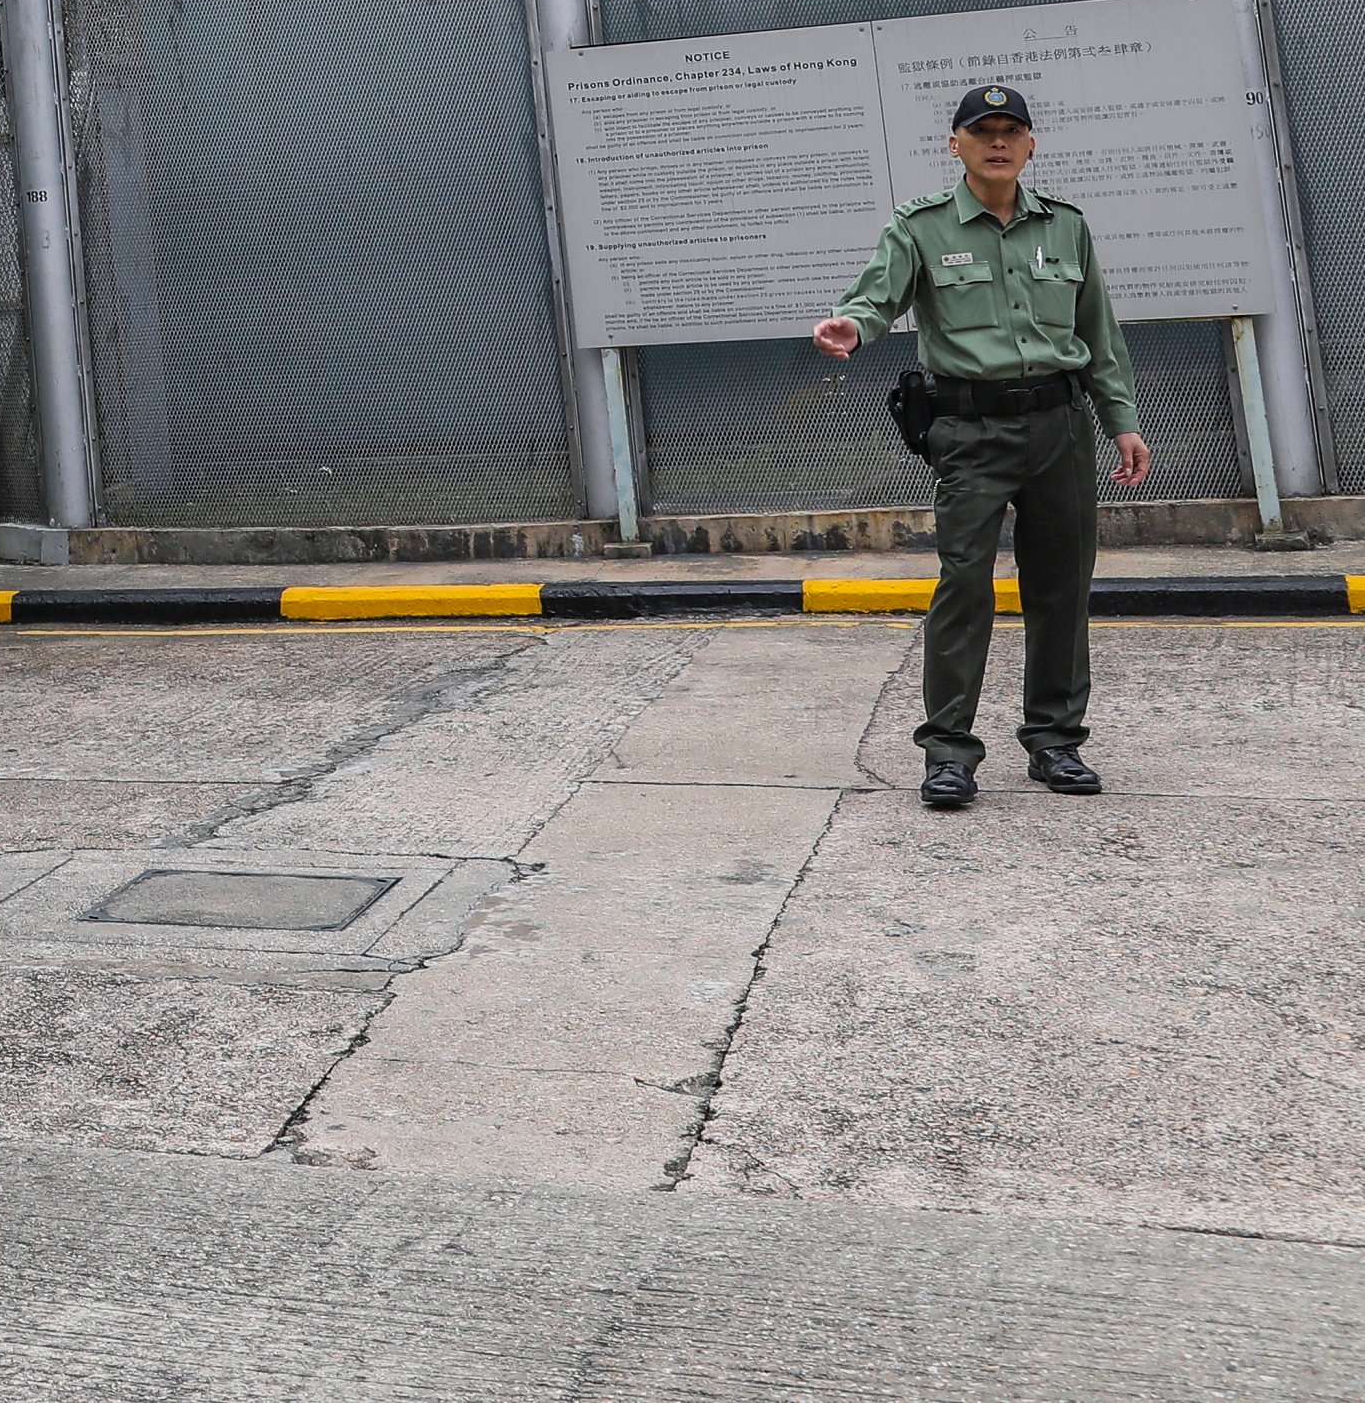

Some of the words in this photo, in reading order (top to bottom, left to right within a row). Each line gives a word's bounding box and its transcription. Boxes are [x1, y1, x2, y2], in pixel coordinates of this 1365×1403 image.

[685, 51, 730, 62] NOTICE
[568, 81, 610, 90] Prisons
[612, 75, 673, 86] Ordinance,
[675, 70, 719, 80] Chapter
[721, 67, 745, 76] 234,
[747, 65, 777, 74] Laws
[779, 62, 791, 71] of
[793, 61, 824, 70] Hong
[826, 58, 857, 67] Kong
[708, 84, 734, 92] prison
[744, 80, 764, 88] legal
[765, 78, 797, 86] custody
[1246, 91, 1264, 106] 90
[644, 149, 695, 158] unauthorized
[743, 143, 769, 151] prison
[26, 190, 48, 203] 188
[637, 238, 688, 247] unauthorized
[729, 234, 767, 242] prisoners
